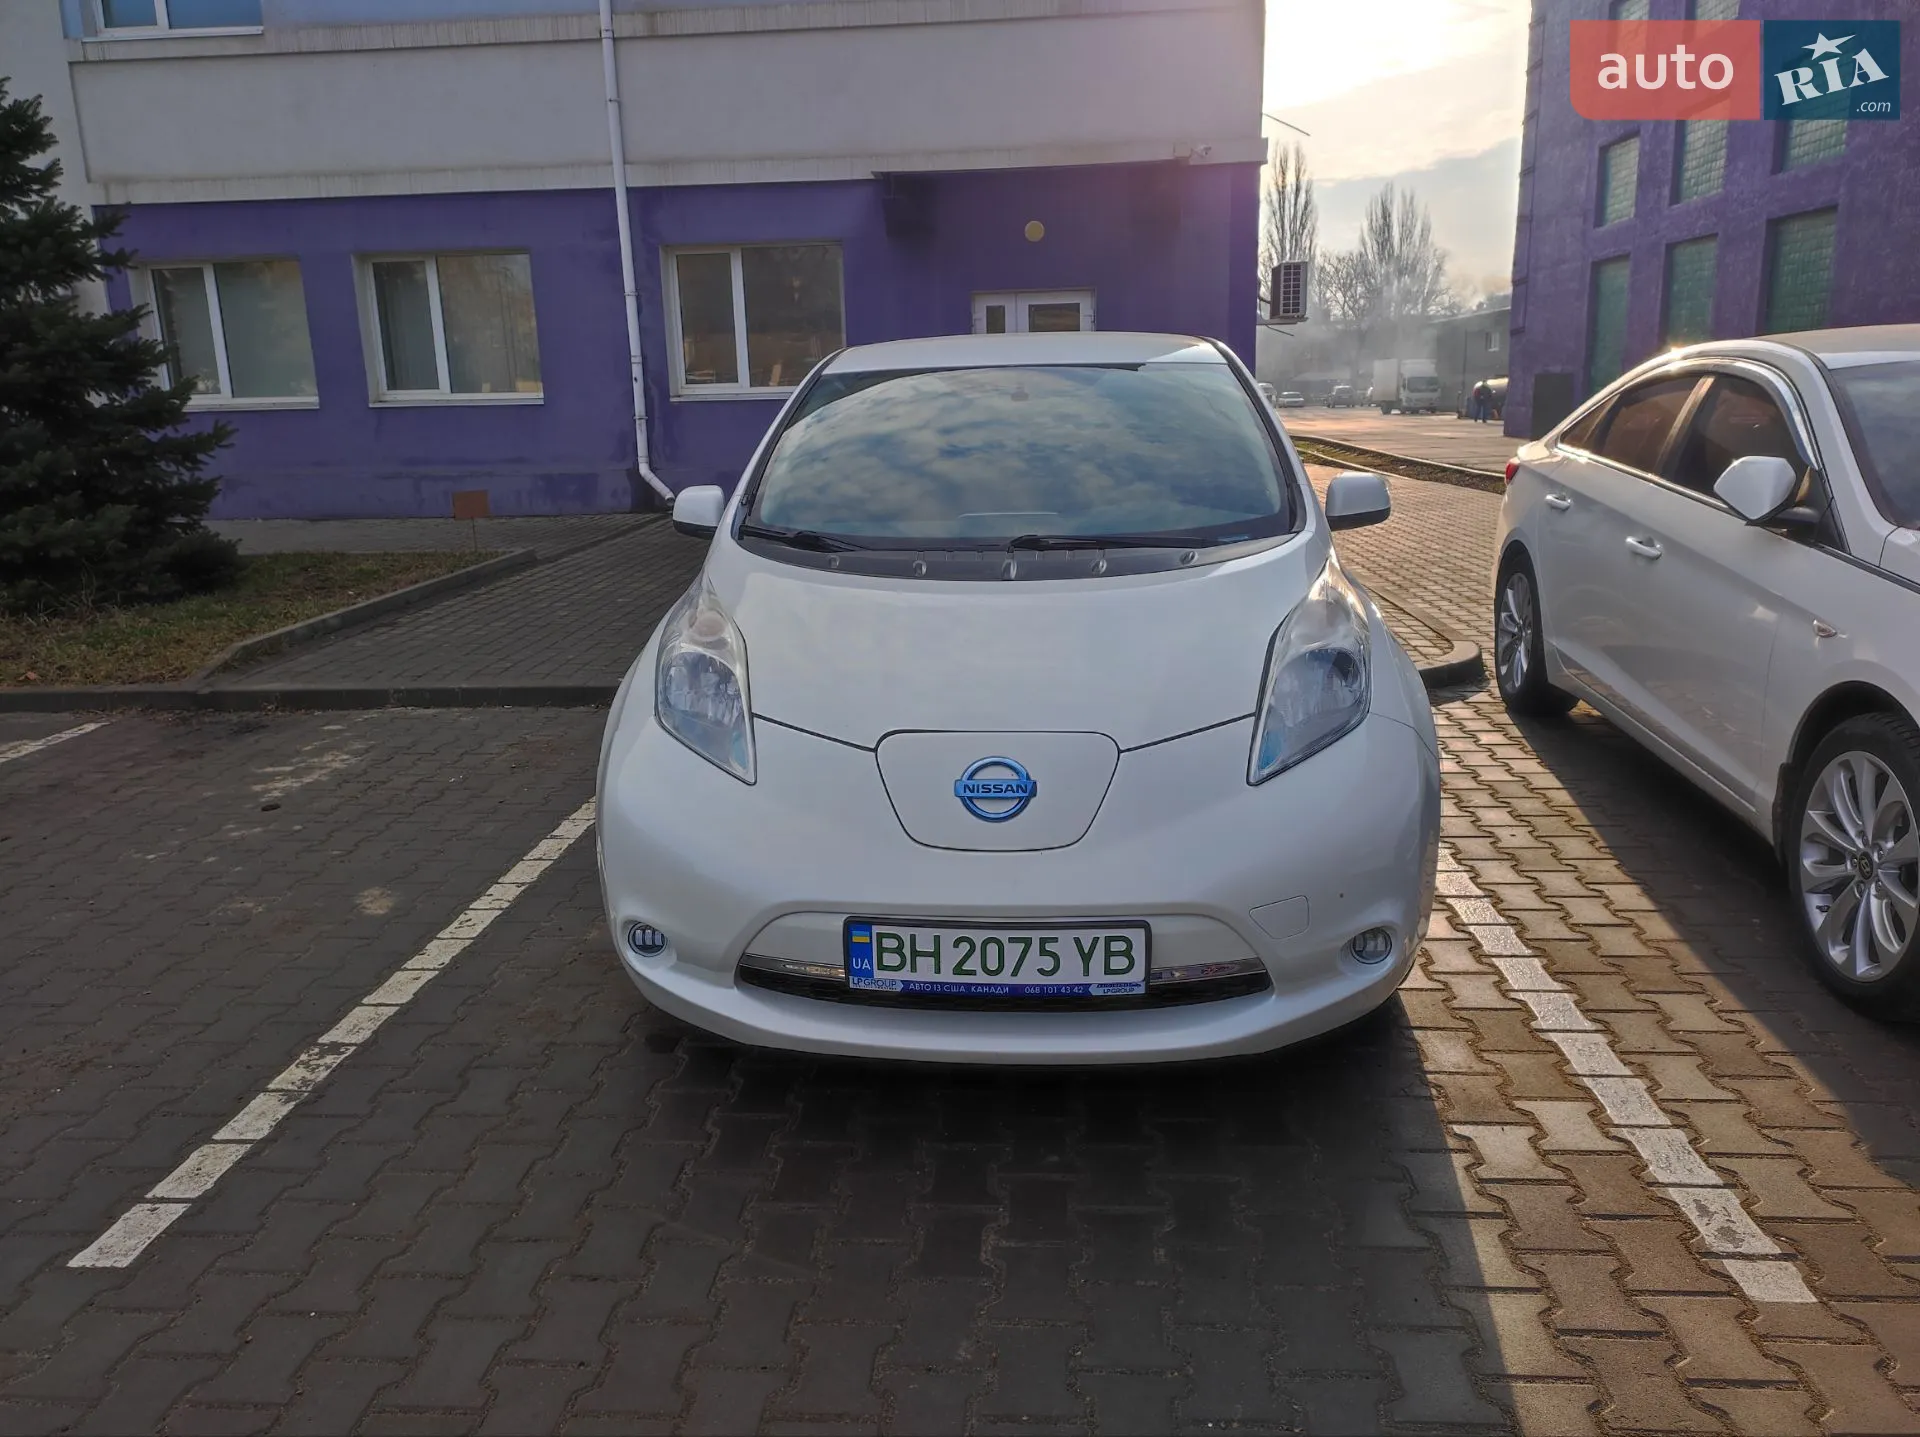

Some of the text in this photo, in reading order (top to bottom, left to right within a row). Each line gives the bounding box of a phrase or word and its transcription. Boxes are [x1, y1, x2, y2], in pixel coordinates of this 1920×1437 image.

[963, 783, 1028, 794] NISSAN
[875, 931, 1136, 978] BH 2075 YB
[852, 957, 872, 971] UA
